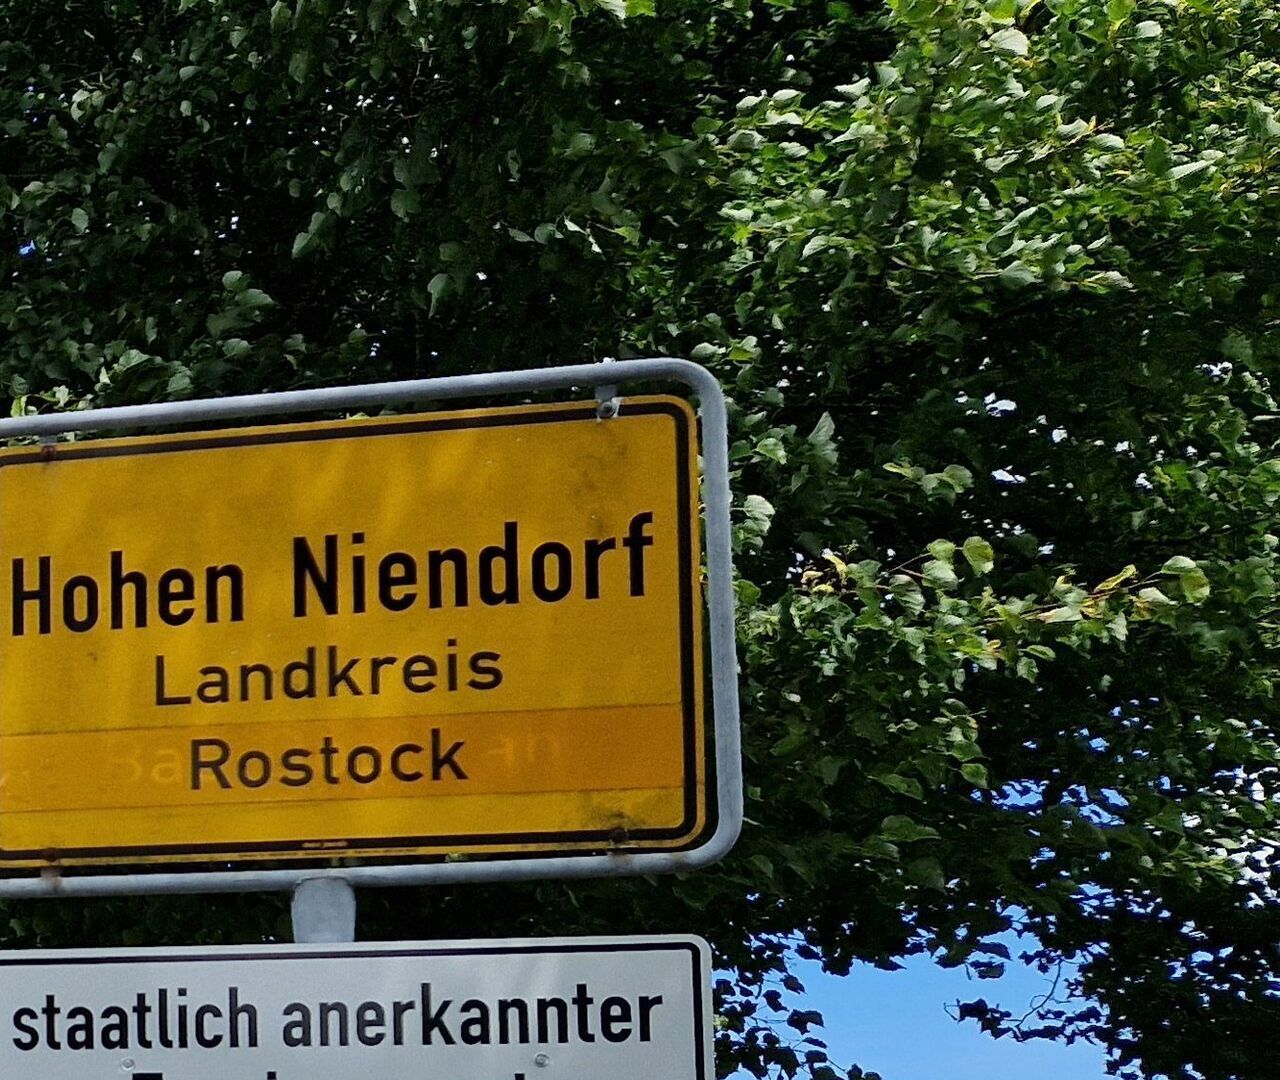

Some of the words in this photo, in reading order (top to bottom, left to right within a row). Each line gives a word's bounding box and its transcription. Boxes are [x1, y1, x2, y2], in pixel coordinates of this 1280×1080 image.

[12, 550, 245, 637] Hohen
[292, 511, 654, 618] Niendorf
[154, 638, 504, 707] Landkreis
[189, 727, 469, 791] Rostock
[12, 987, 258, 1051] staatlich
[282, 982, 663, 1048] anerkannter
